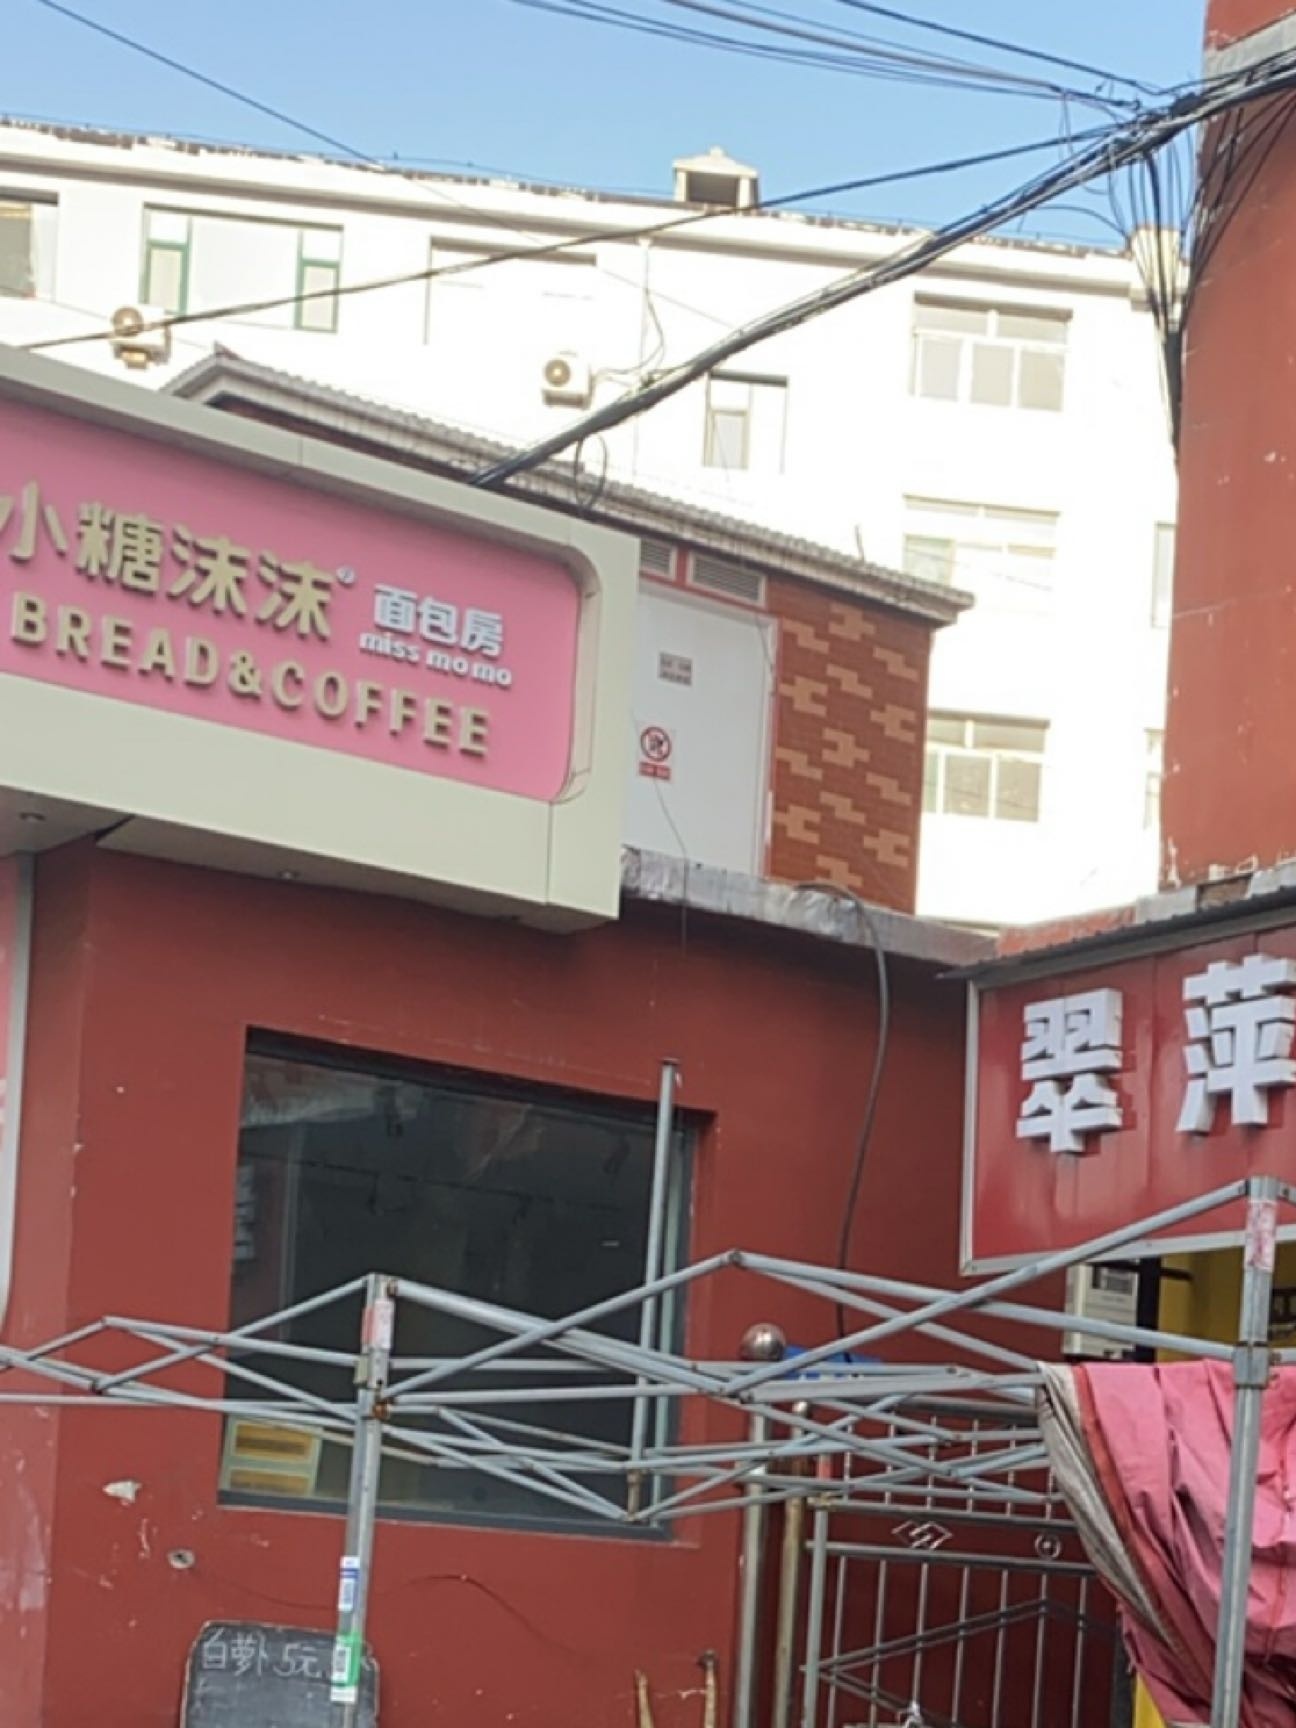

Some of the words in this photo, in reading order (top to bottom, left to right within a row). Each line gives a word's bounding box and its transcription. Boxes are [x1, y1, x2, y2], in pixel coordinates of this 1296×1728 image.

[359, 631, 420, 664] miss
[374, 583, 503, 658] 面包房
[11, 592, 490, 757] BREAD&COFFEE
